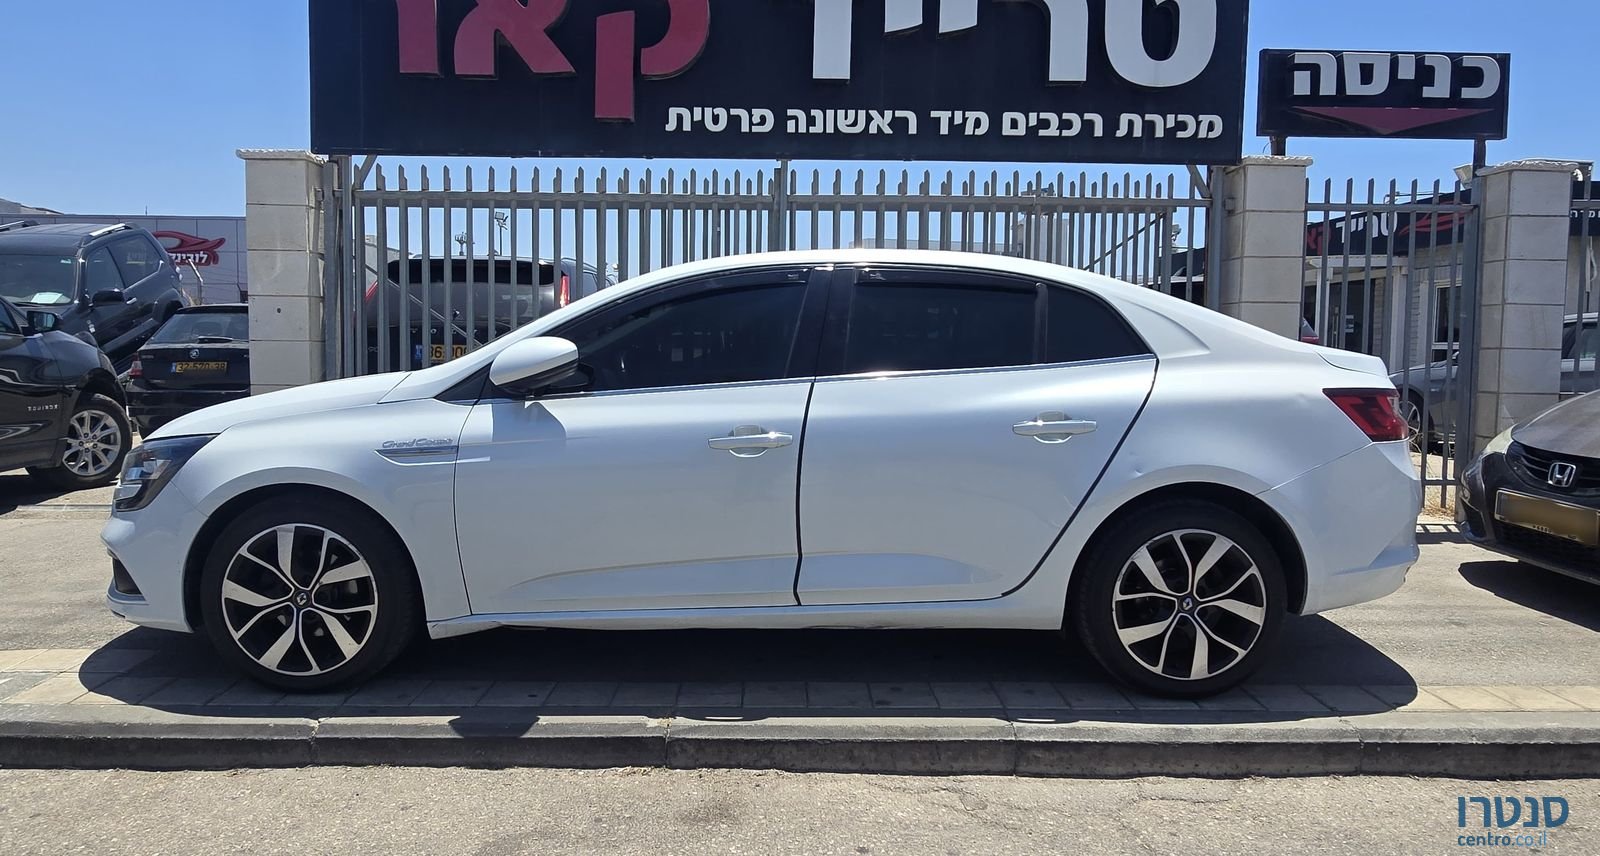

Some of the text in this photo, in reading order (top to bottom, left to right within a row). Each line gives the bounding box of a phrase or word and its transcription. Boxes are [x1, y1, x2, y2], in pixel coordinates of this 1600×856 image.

[1292, 51, 1501, 99] כניסה
[665, 106, 1223, 139] מכירת רכבים מיד ראשונה פרטית
